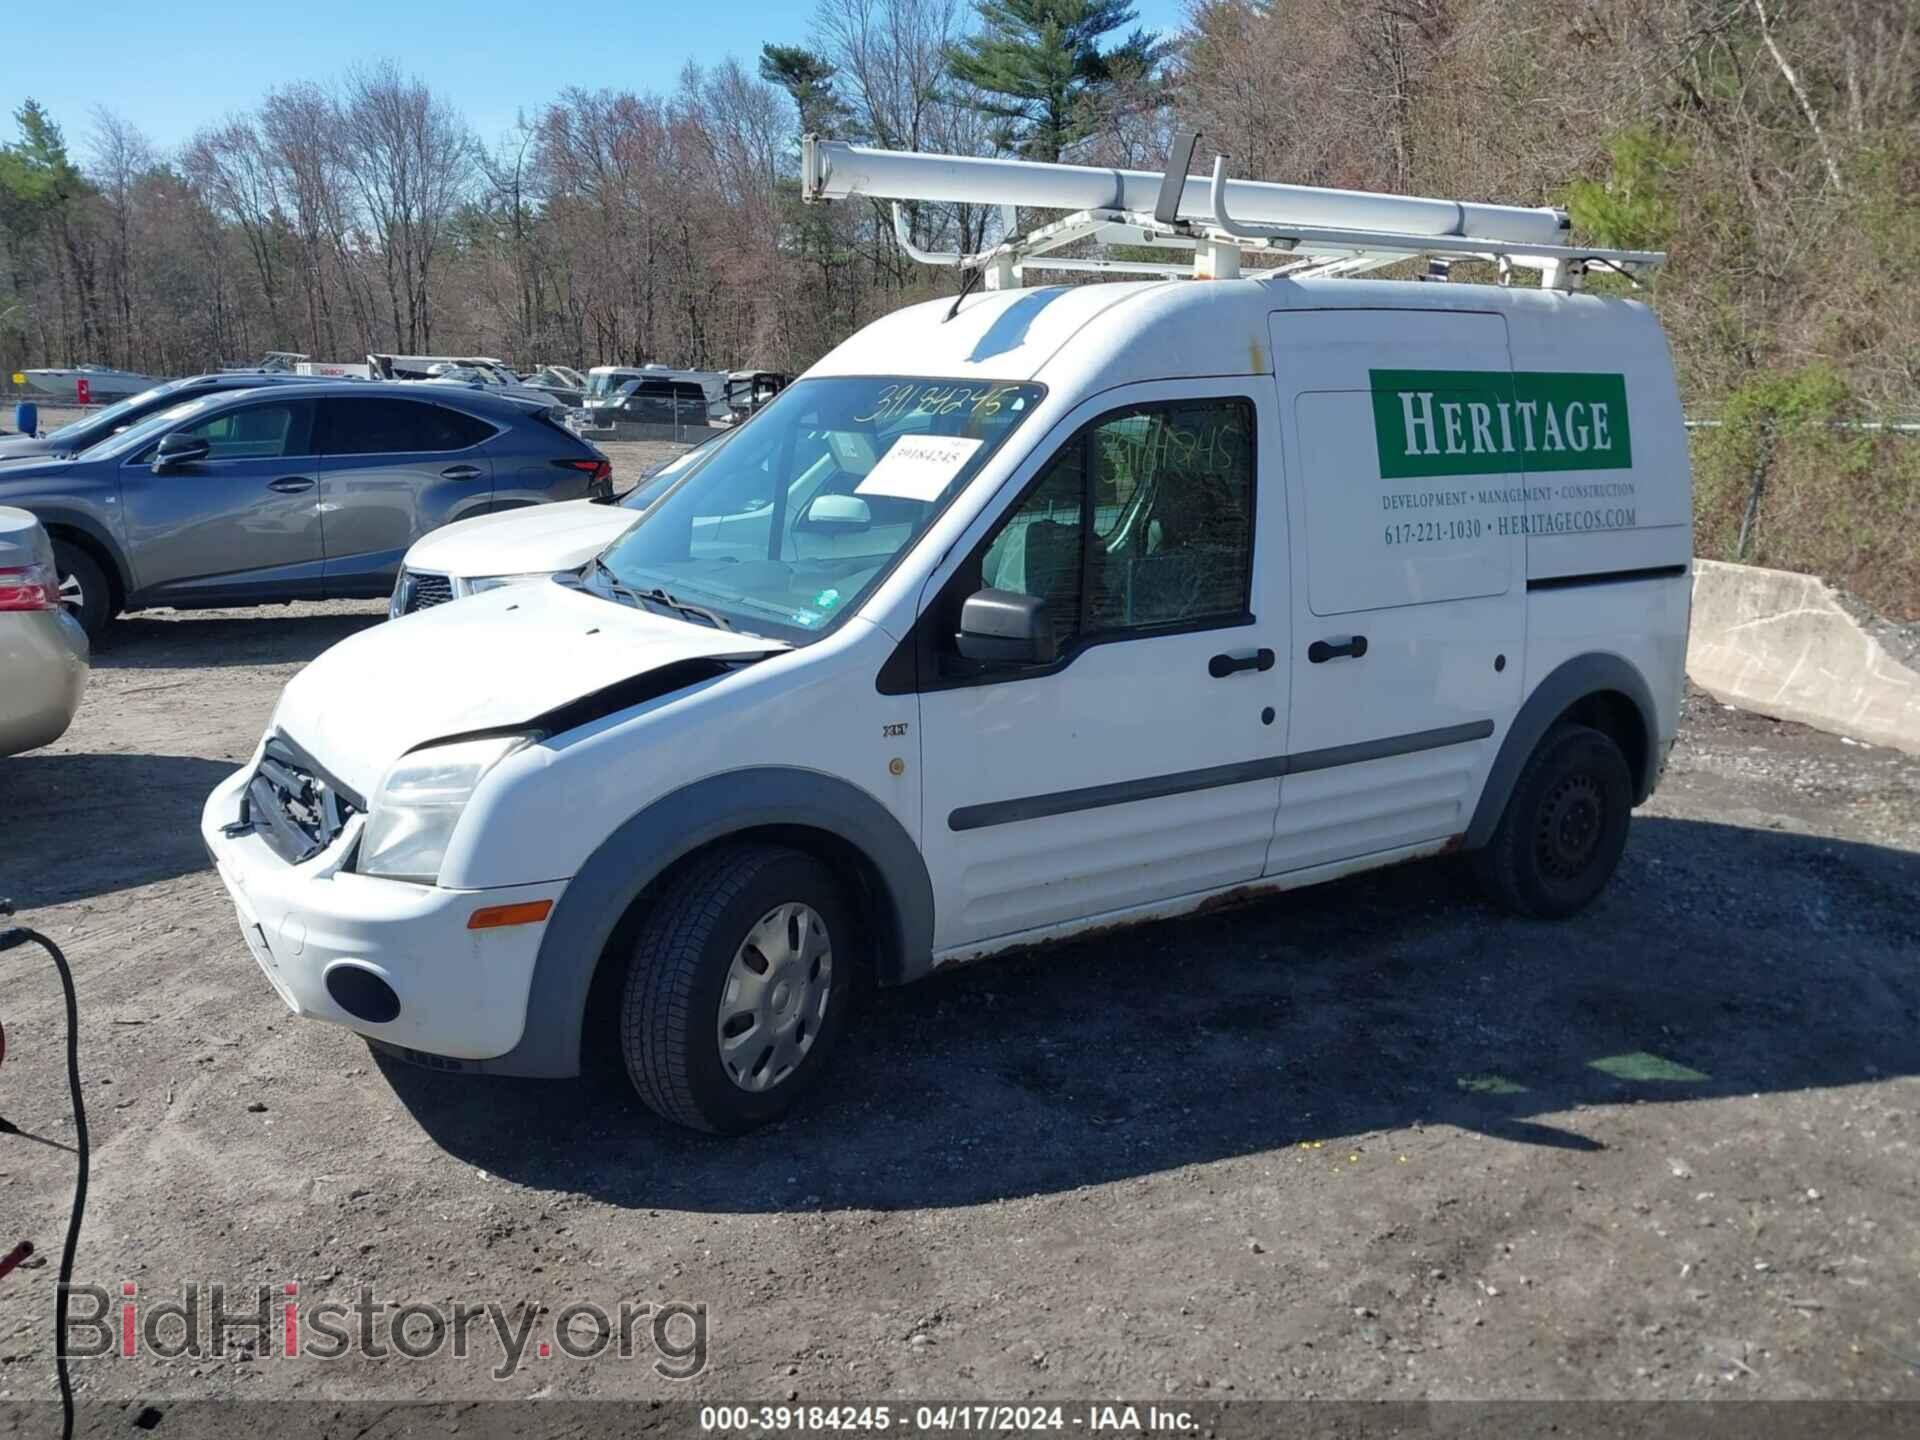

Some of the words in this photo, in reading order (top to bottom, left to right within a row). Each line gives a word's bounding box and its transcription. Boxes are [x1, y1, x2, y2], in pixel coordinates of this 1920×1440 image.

[1398, 391, 1612, 455] HERITAGE
[1382, 491, 1467, 510] DEVELOPMENT
[1478, 487, 1552, 504] MANAGEMENT
[1561, 482, 1635, 499] CONSTRUCTION
[1384, 519, 1481, 545] 617-221-1030
[1498, 508, 1636, 536] HERITAGECOS.COM
